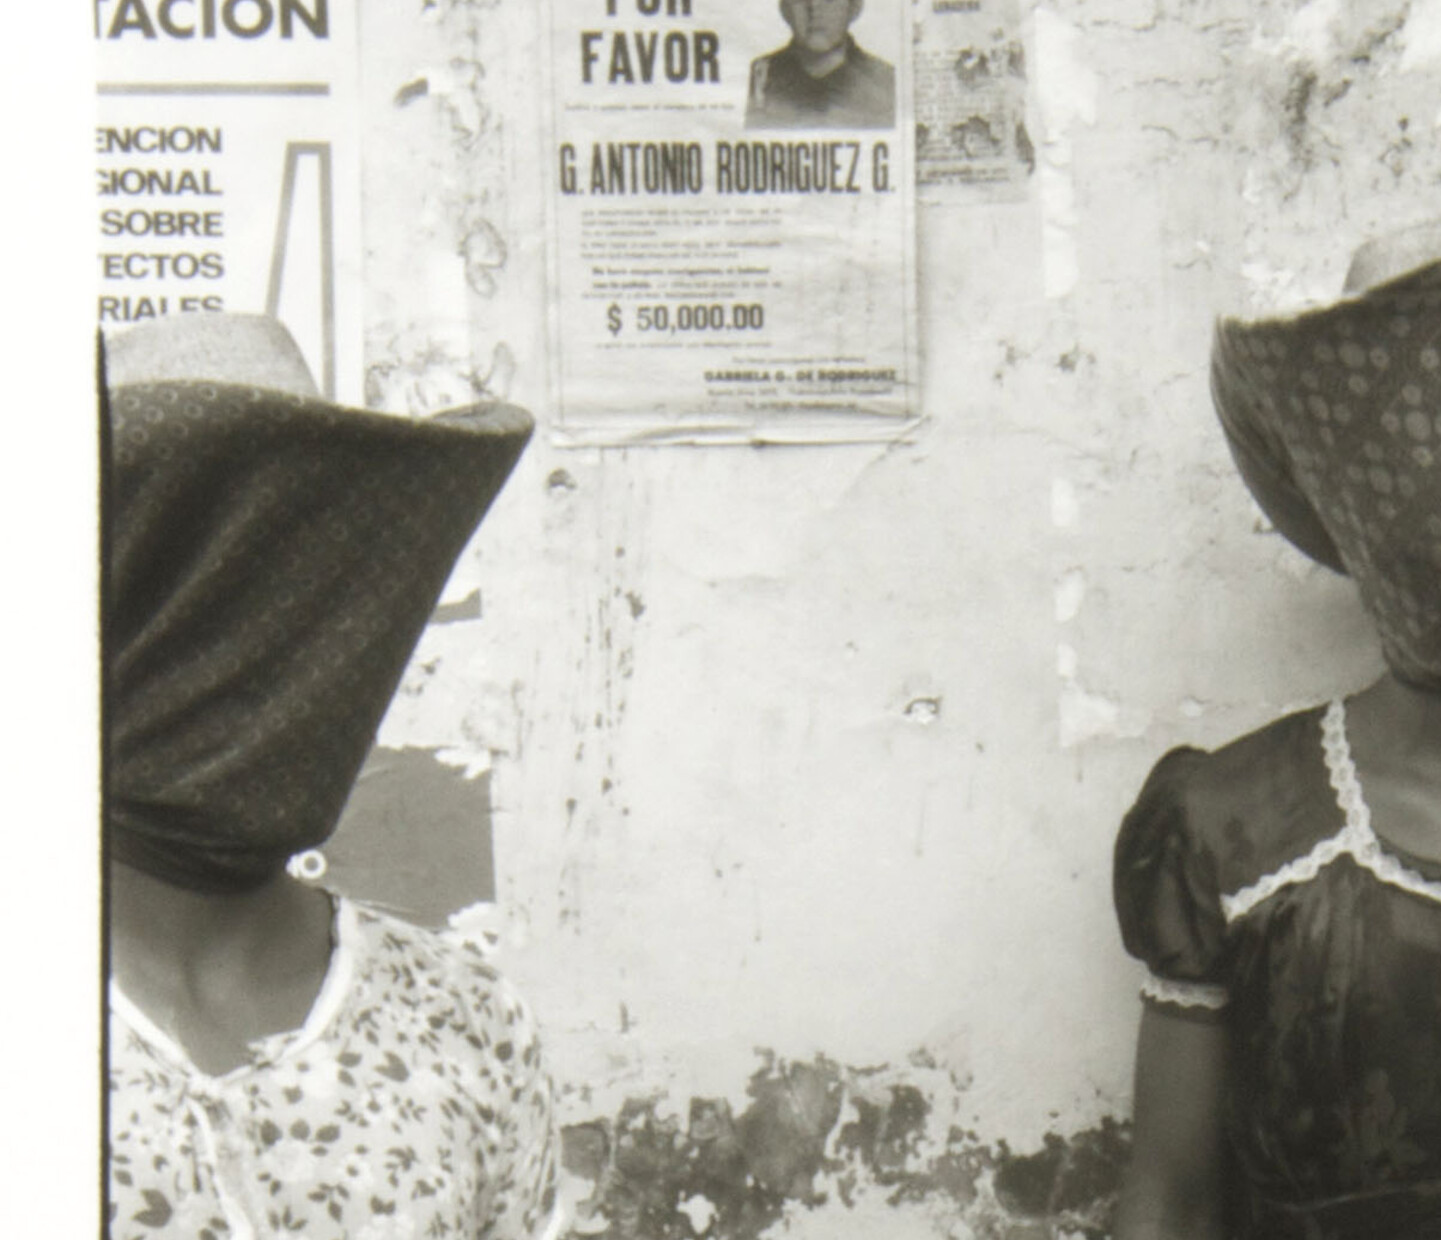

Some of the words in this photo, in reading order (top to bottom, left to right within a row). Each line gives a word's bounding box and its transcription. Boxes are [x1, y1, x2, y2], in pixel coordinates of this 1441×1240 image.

[581, 31, 720, 84] FAVOR
[560, 143, 584, 194] G.
[590, 142, 703, 194] ANTONIO
[716, 141, 861, 194] RODRIGUEZ
[872, 142, 896, 194] G.
[100, 209, 224, 237] SOBRE
[607, 303, 622, 336] $
[636, 304, 765, 334] 50,000.00
[704, 370, 771, 382] GABRIELA
